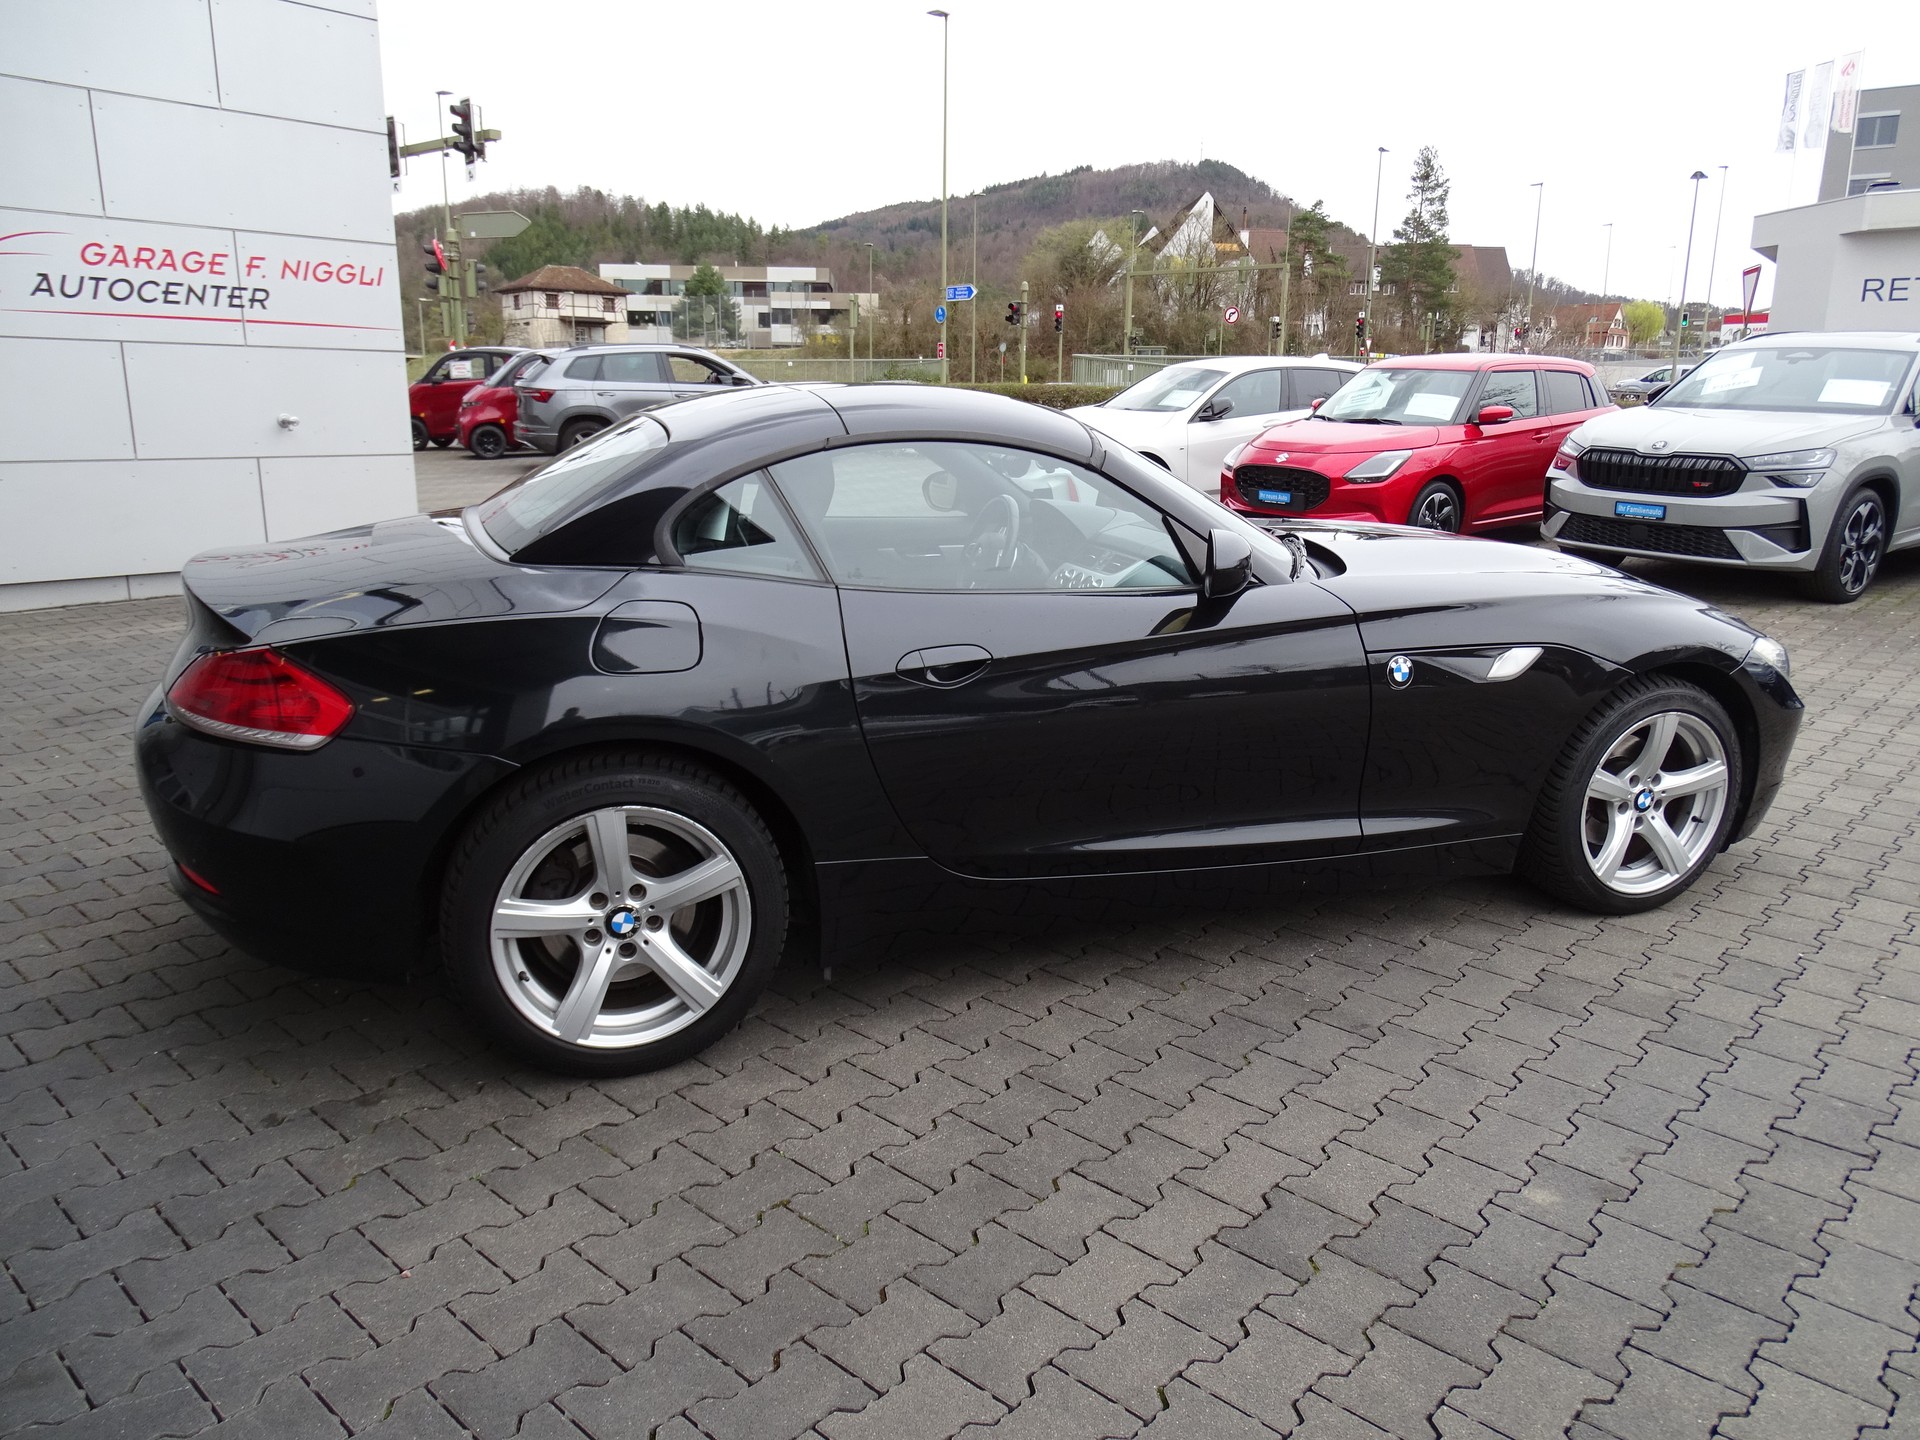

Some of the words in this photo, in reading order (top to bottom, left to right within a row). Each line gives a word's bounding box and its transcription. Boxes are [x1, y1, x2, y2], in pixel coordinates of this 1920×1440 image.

[80, 242, 228, 276] GARAGE
[245, 256, 266, 279] F.
[281, 260, 384, 287] NIGGLI
[30, 272, 270, 310] AUTOCENTER
[1861, 277, 1920, 302] RE
[542, 779, 635, 810] WinterContact
